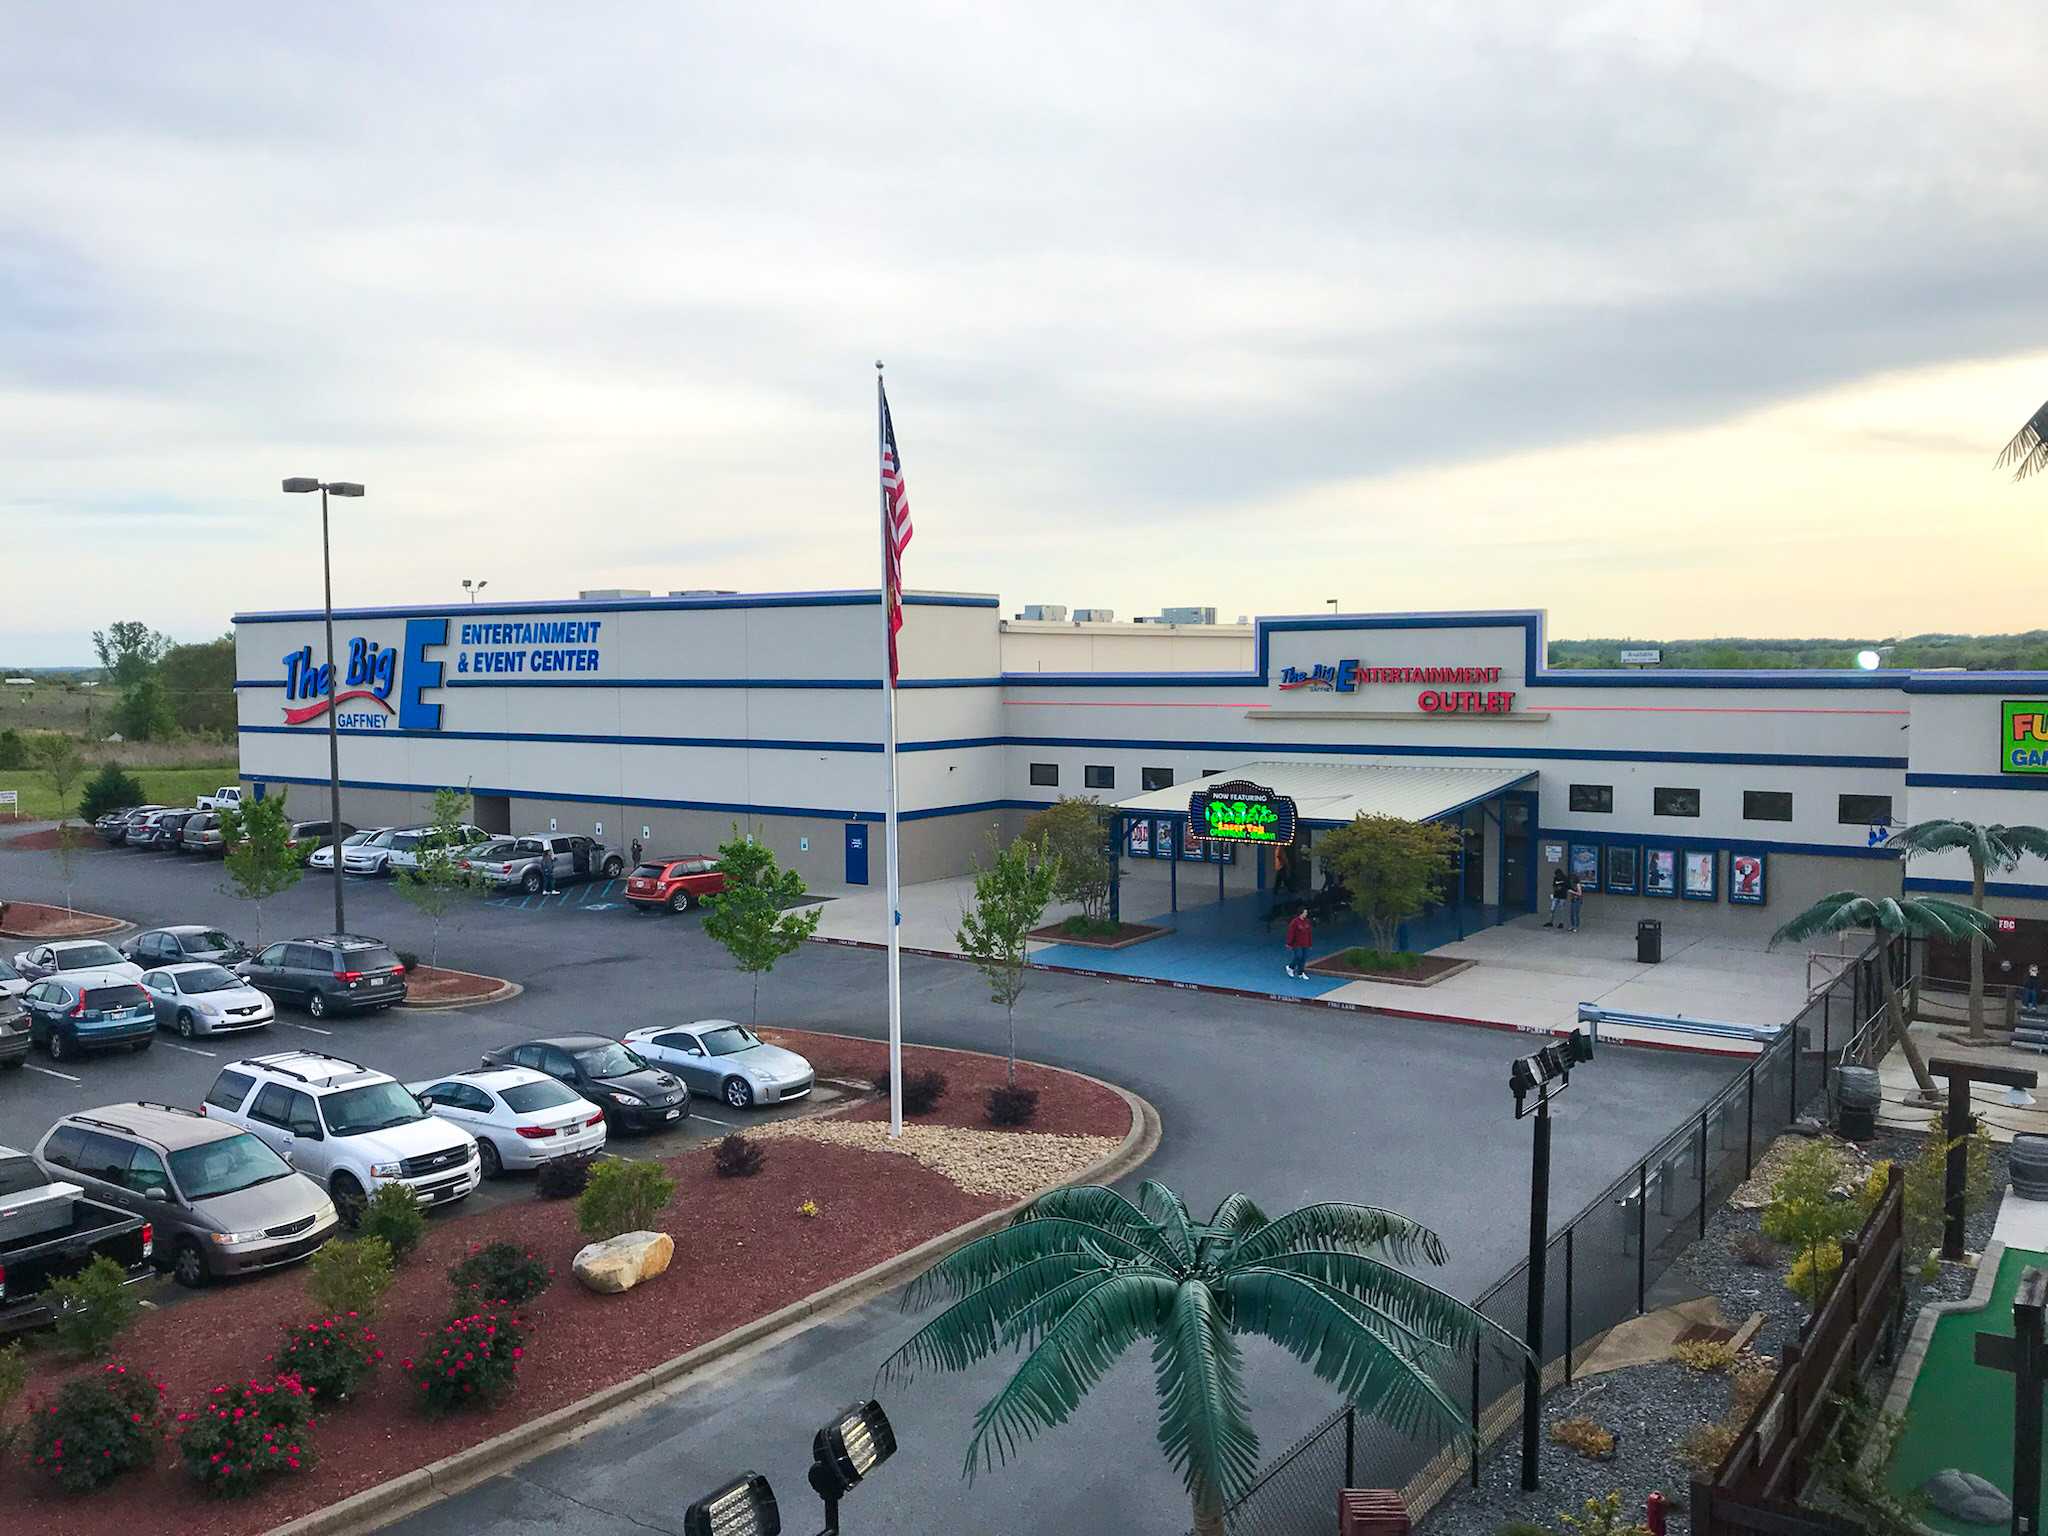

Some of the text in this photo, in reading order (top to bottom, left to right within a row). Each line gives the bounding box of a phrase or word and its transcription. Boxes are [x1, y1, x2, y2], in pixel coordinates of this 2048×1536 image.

[461, 621, 601, 645] ENTERTAINMENT
[458, 649, 599, 673] & EVENT CENTER
[282, 618, 450, 730] The Big E
[1281, 666, 1307, 683] The
[1312, 664, 1335, 682] Big
[1418, 690, 1516, 713] OUTLET
[338, 713, 389, 729] GAFFNEY
[1230, 794, 1267, 802] FEATURING
[1218, 822, 1264, 834] Laser Tag
[1999, 920, 2015, 929] FDC
